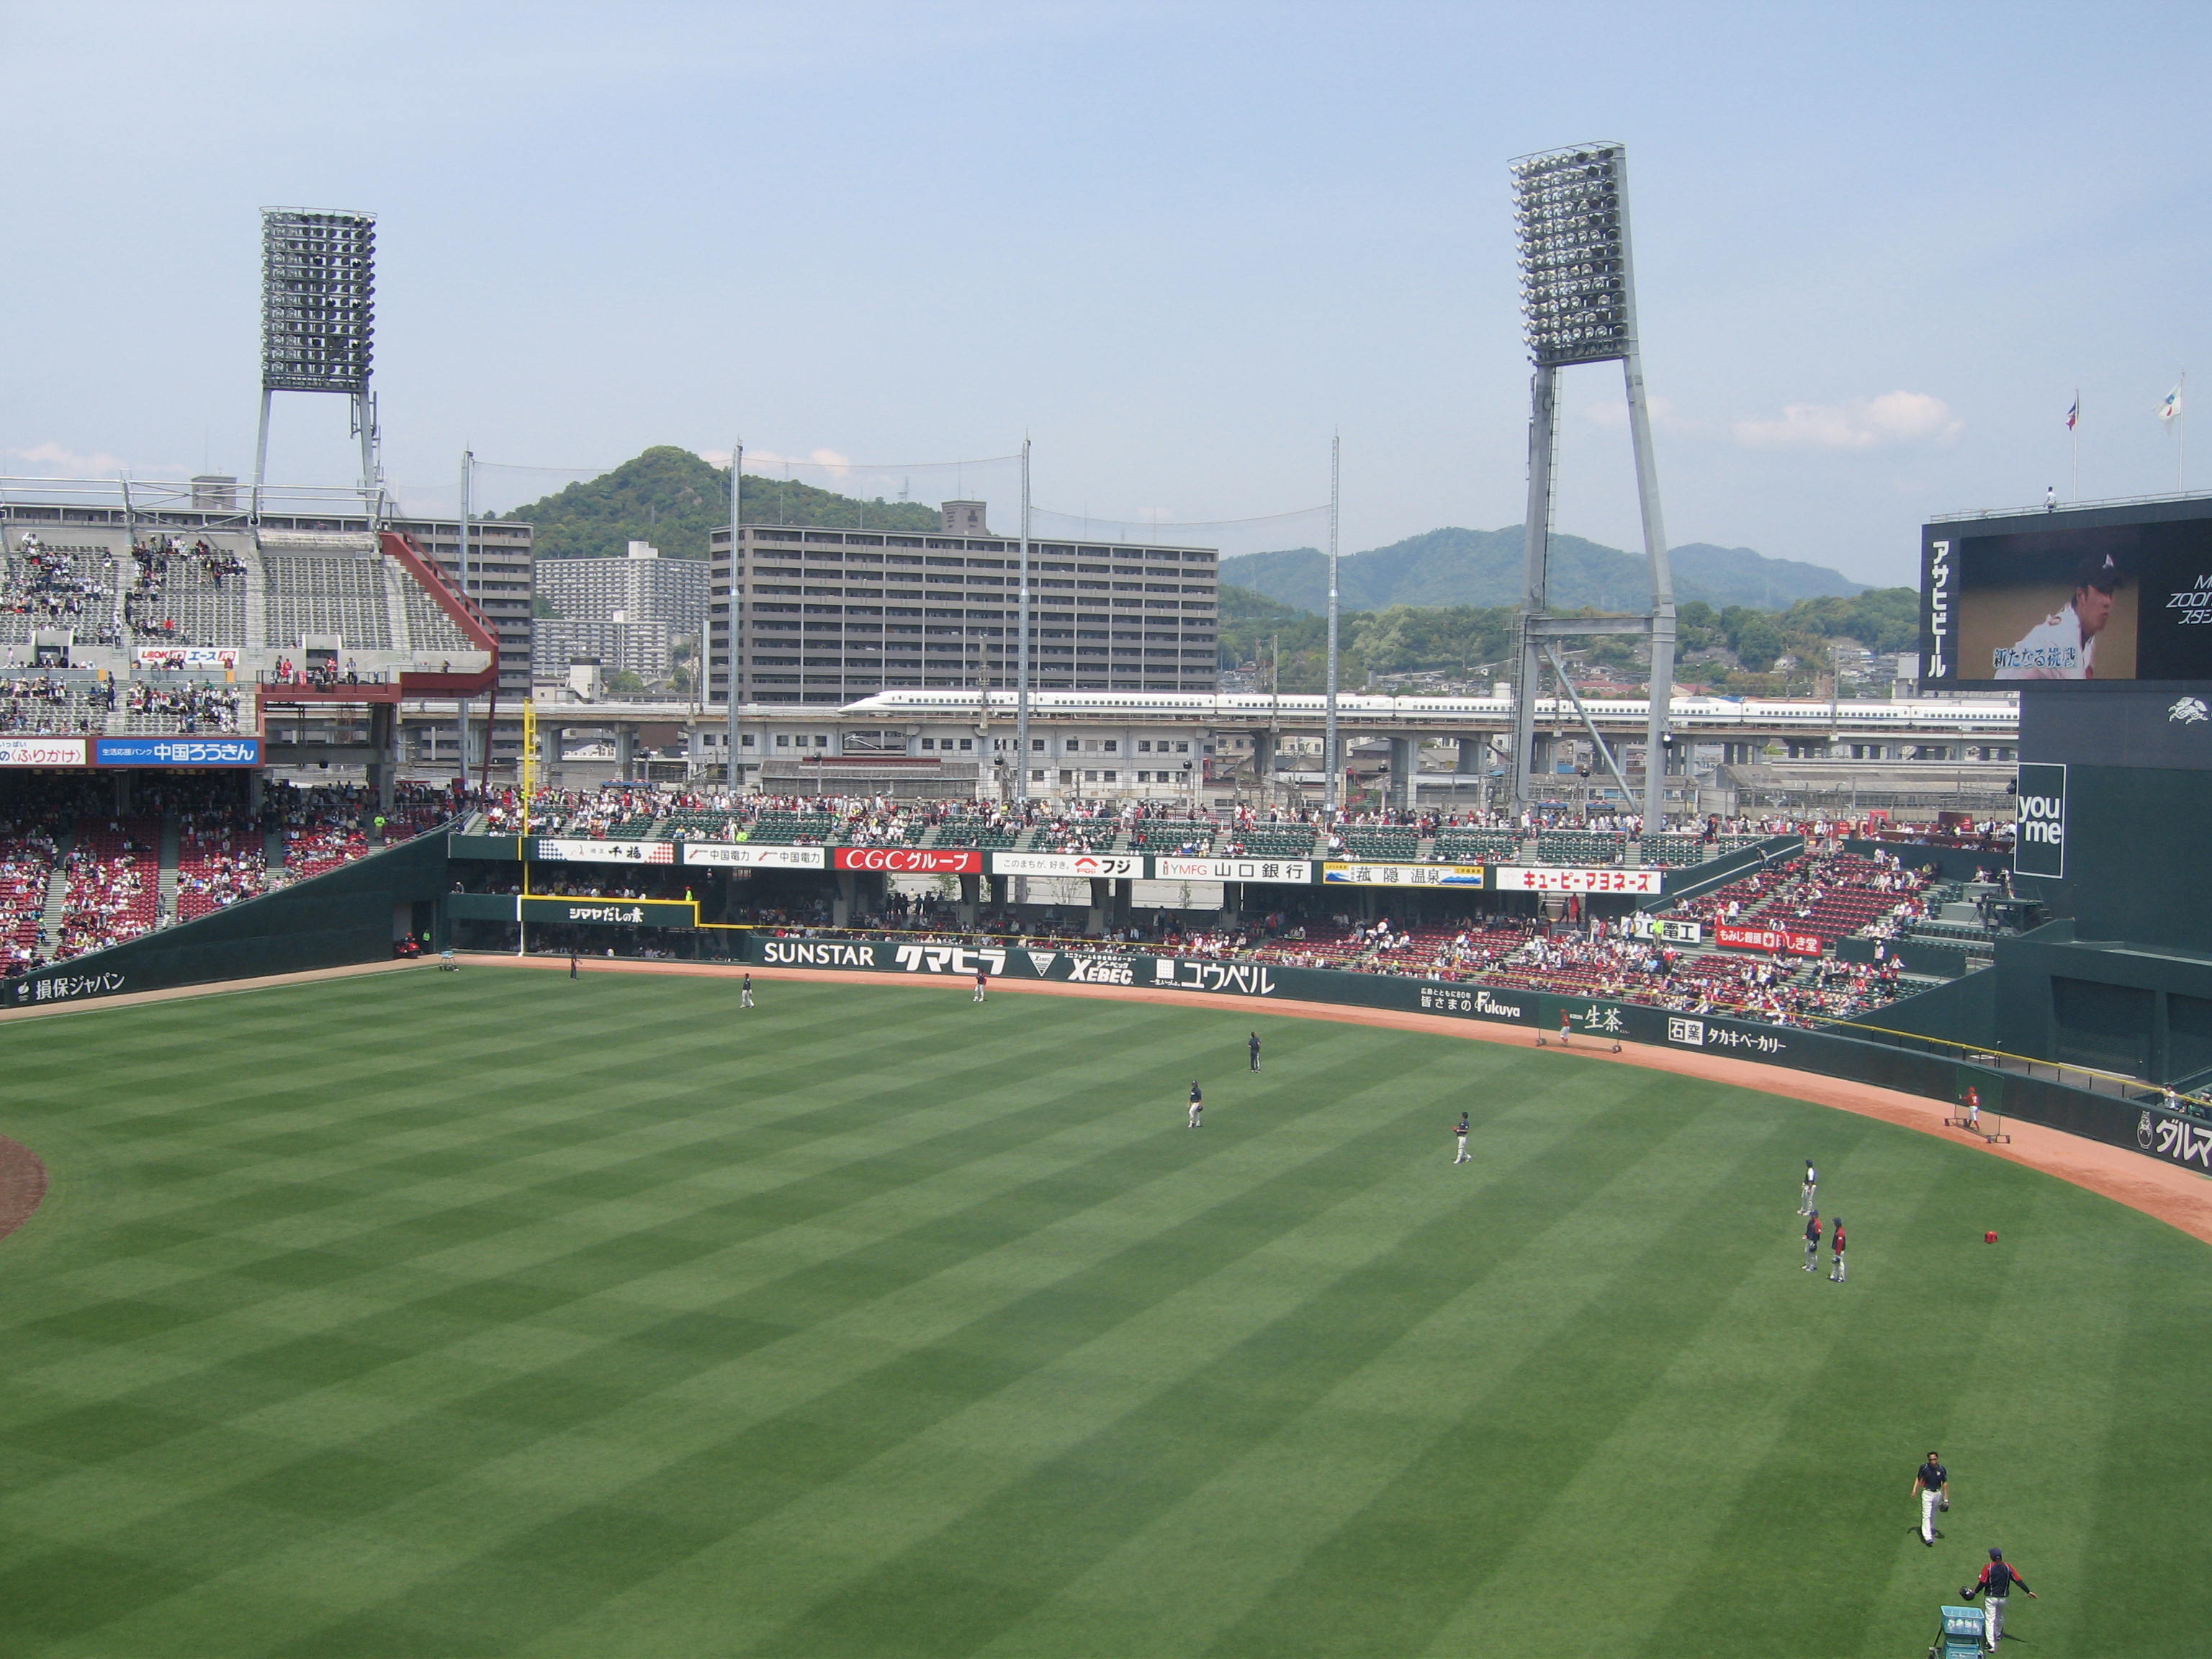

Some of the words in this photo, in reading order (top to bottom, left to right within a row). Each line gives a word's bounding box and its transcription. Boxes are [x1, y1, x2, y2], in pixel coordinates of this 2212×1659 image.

[2194, 575, 2212, 590] M
[1928, 541, 1949, 678] アサヒビール
[188, 651, 216, 661] エース
[153, 743, 254, 761] 中国ろうきん
[2018, 796, 2060, 824] you
[2026, 821, 2062, 845] me
[710, 850, 750, 862] 中国電力
[780, 852, 820, 863] 中国電力
[1003, 859, 1069, 870] このまちが、好き。
[1102, 859, 1130, 874] フジ
[1171, 863, 1208, 876] YMFG
[1215, 863, 1303, 879] 山口銀行
[570, 907, 644, 923] シマヤだしの素
[1719, 929, 1762, 945] もみじ饅頭
[764, 943, 876, 966] SUNSTAR
[895, 945, 1007, 975] クマヒラ
[1067, 958, 1133, 985] XEBEC
[36, 972, 125, 1000] 損保ジャパン
[1421, 995, 1472, 1012] 皆さまの
[1475, 991, 1521, 1017] Fukuya
[1584, 1004, 1624, 1033] 生茶
[1707, 1028, 1786, 1053] タカキベーカリー
[2156, 1118, 2212, 1167] ダルマ
